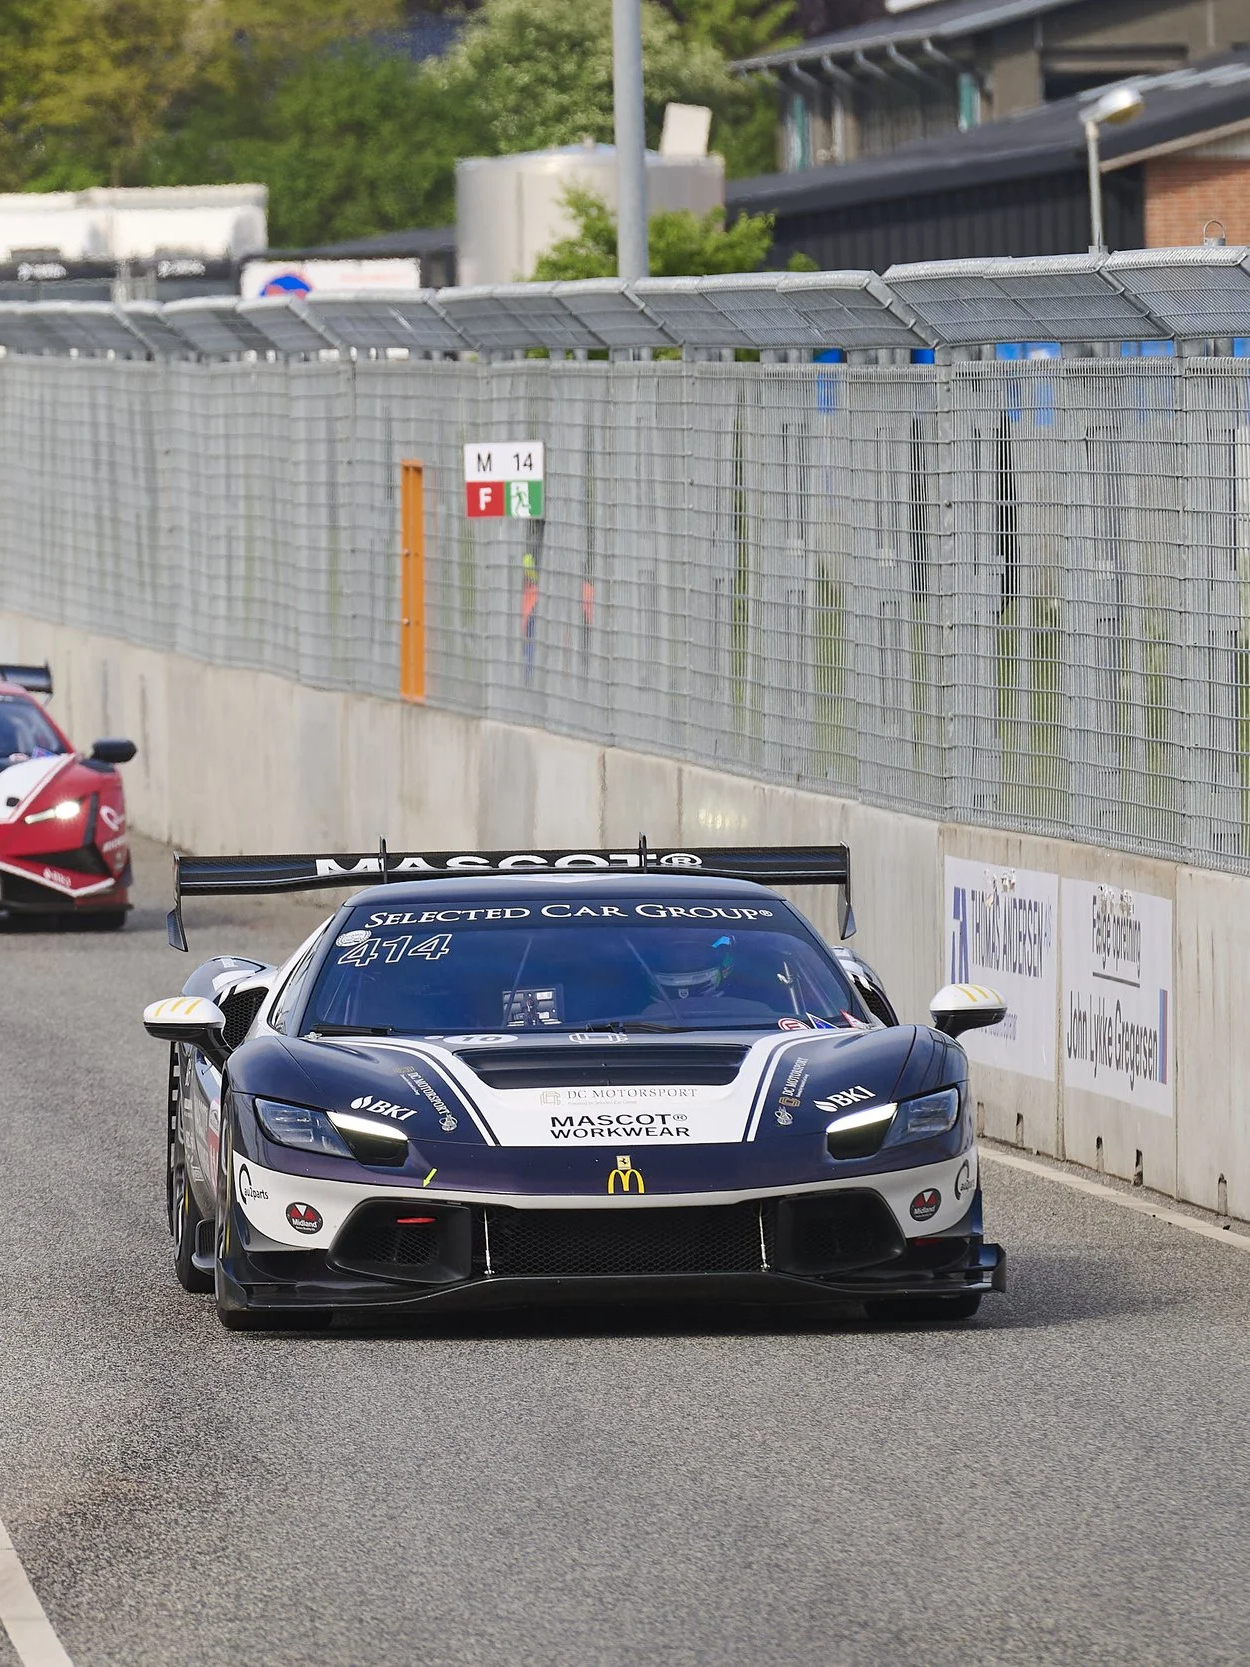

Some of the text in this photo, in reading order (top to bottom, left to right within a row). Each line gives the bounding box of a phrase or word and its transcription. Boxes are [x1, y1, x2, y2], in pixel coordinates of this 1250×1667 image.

[477, 453, 533, 472] M 14
[479, 487, 493, 511] F
[365, 907, 532, 929] SELECTED
[541, 904, 629, 918] CAR
[971, 889, 1001, 972] THOMAS
[1001, 896, 1044, 979] ANDERSEN
[337, 933, 453, 967] 414
[1067, 990, 1088, 1060] John
[1089, 994, 1113, 1078] Lykke
[1115, 999, 1159, 1091] Gregersen
[567, 1088, 698, 1099] DC MOTORSPORT
[826, 1085, 877, 1107] BKI
[366, 1100, 418, 1121] BKI
[550, 1127, 691, 1139] WORKWEAR
[291, 1218, 318, 1228] Midland
